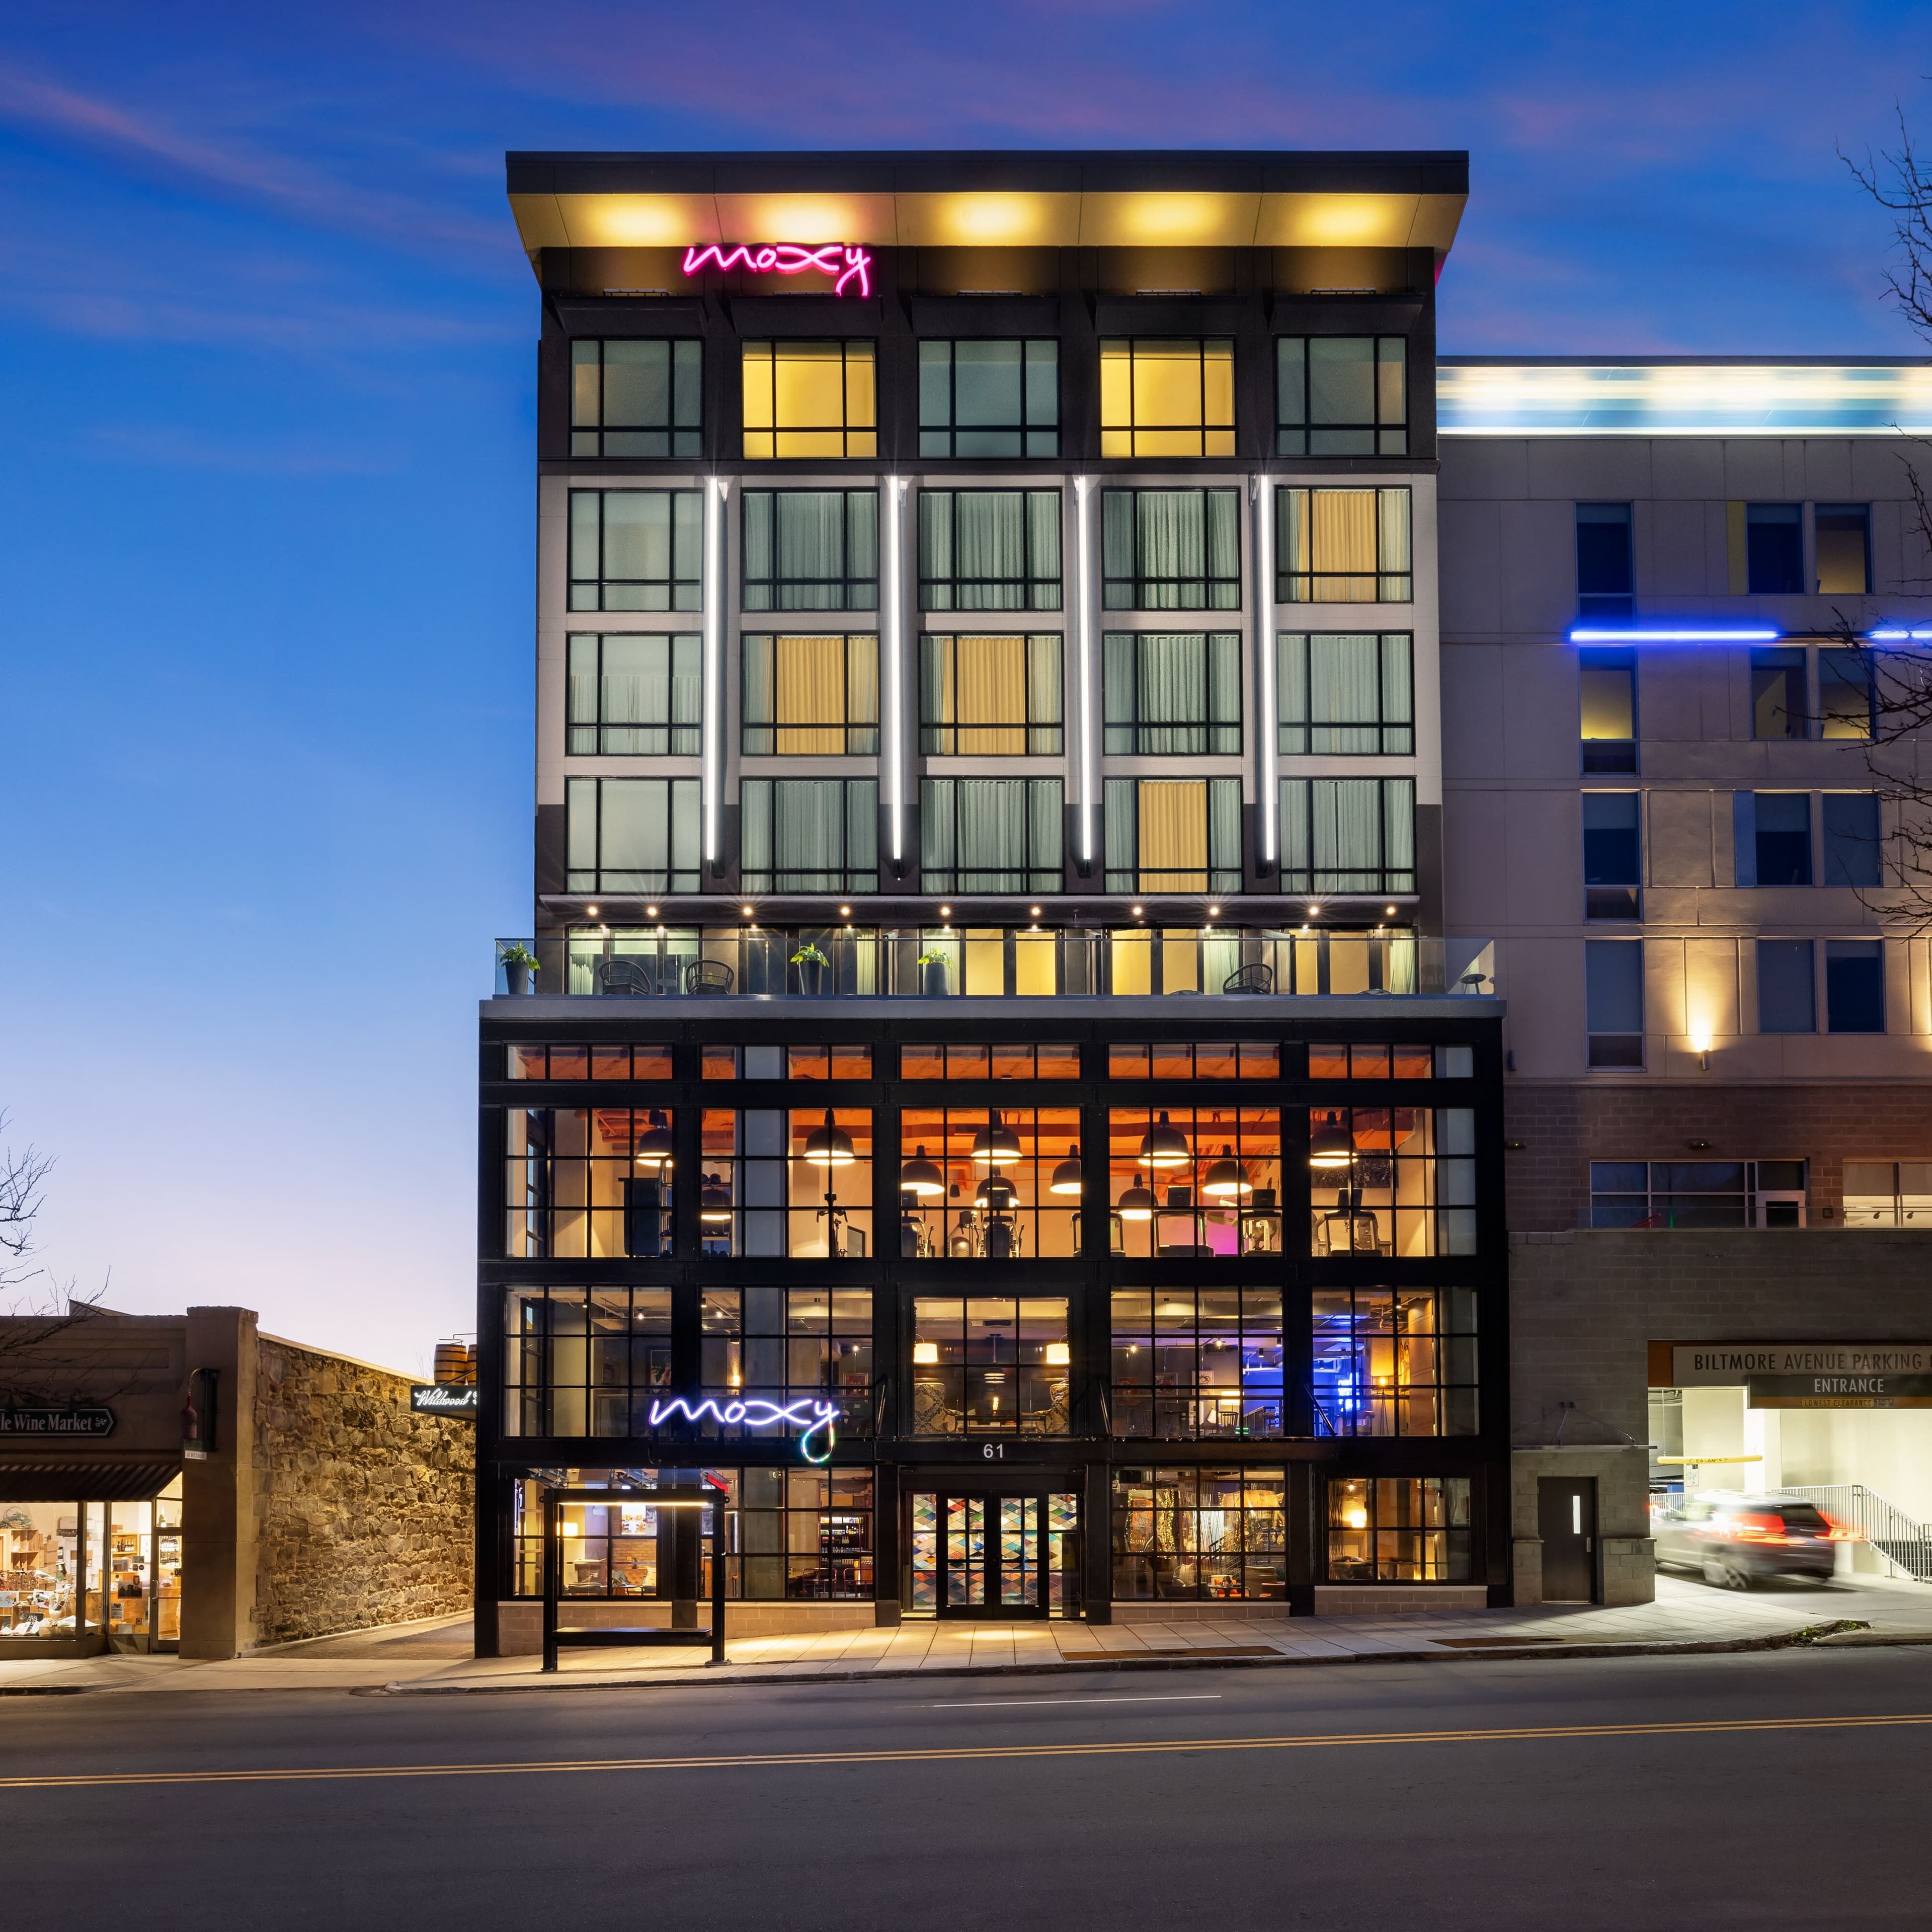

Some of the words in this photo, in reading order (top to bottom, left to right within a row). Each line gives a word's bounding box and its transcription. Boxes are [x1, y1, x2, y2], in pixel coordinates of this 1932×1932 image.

[684, 246, 871, 296] moxy
[1695, 1354, 1776, 1370] BILTMORE
[1784, 1353, 1844, 1370] AVENUE
[1853, 1353, 1921, 1370] PARKING
[1814, 1379, 1884, 1393] ENTRANCE
[414, 1388, 472, 1406] Wildwood
[14, 1414, 45, 1430] Wine
[47, 1413, 92, 1430] Market
[649, 1397, 839, 1463] moxy
[984, 1443, 1003, 1458] 61
